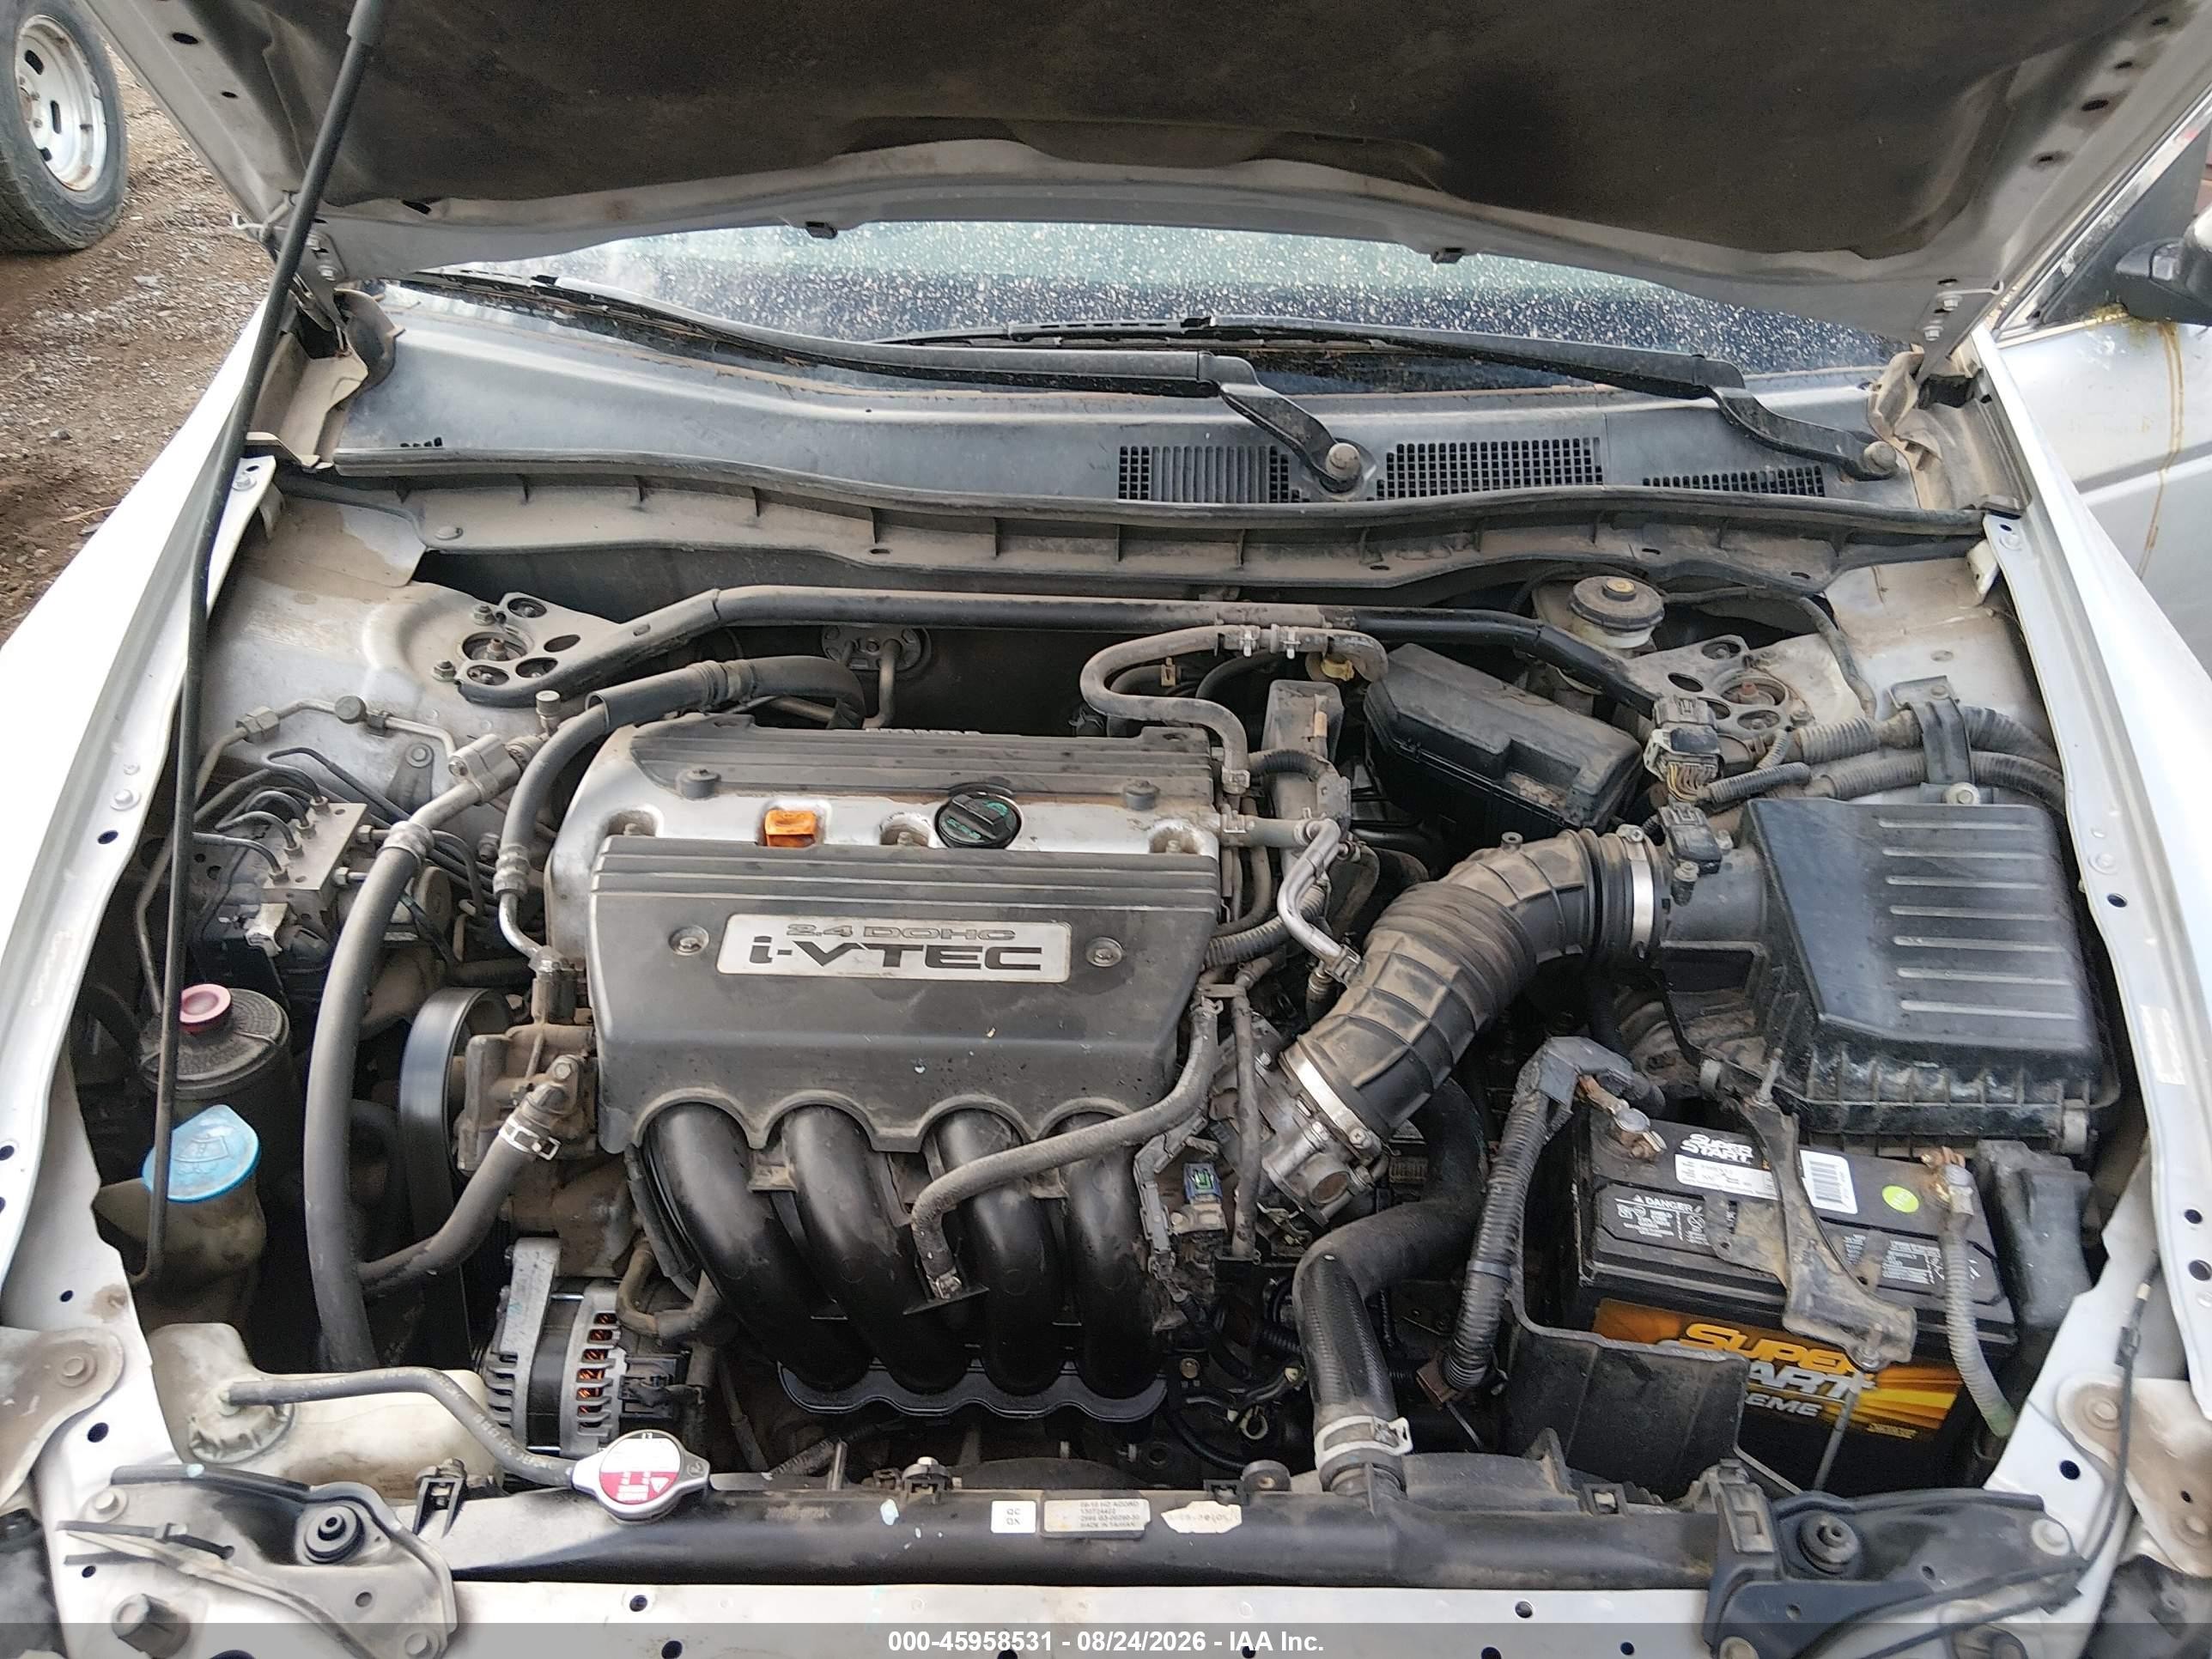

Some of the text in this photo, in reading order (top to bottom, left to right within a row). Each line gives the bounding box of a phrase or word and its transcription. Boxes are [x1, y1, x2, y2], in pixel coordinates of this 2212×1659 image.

[785, 924, 1016, 940] 2.4 DOHC
[749, 935, 1042, 971] i-VTEC
[1680, 1139, 1753, 1164] START
[1689, 1133, 1753, 1157] SUPER
[1644, 1196, 1693, 1212] DANGER
[1748, 1361, 1870, 1399] ART
